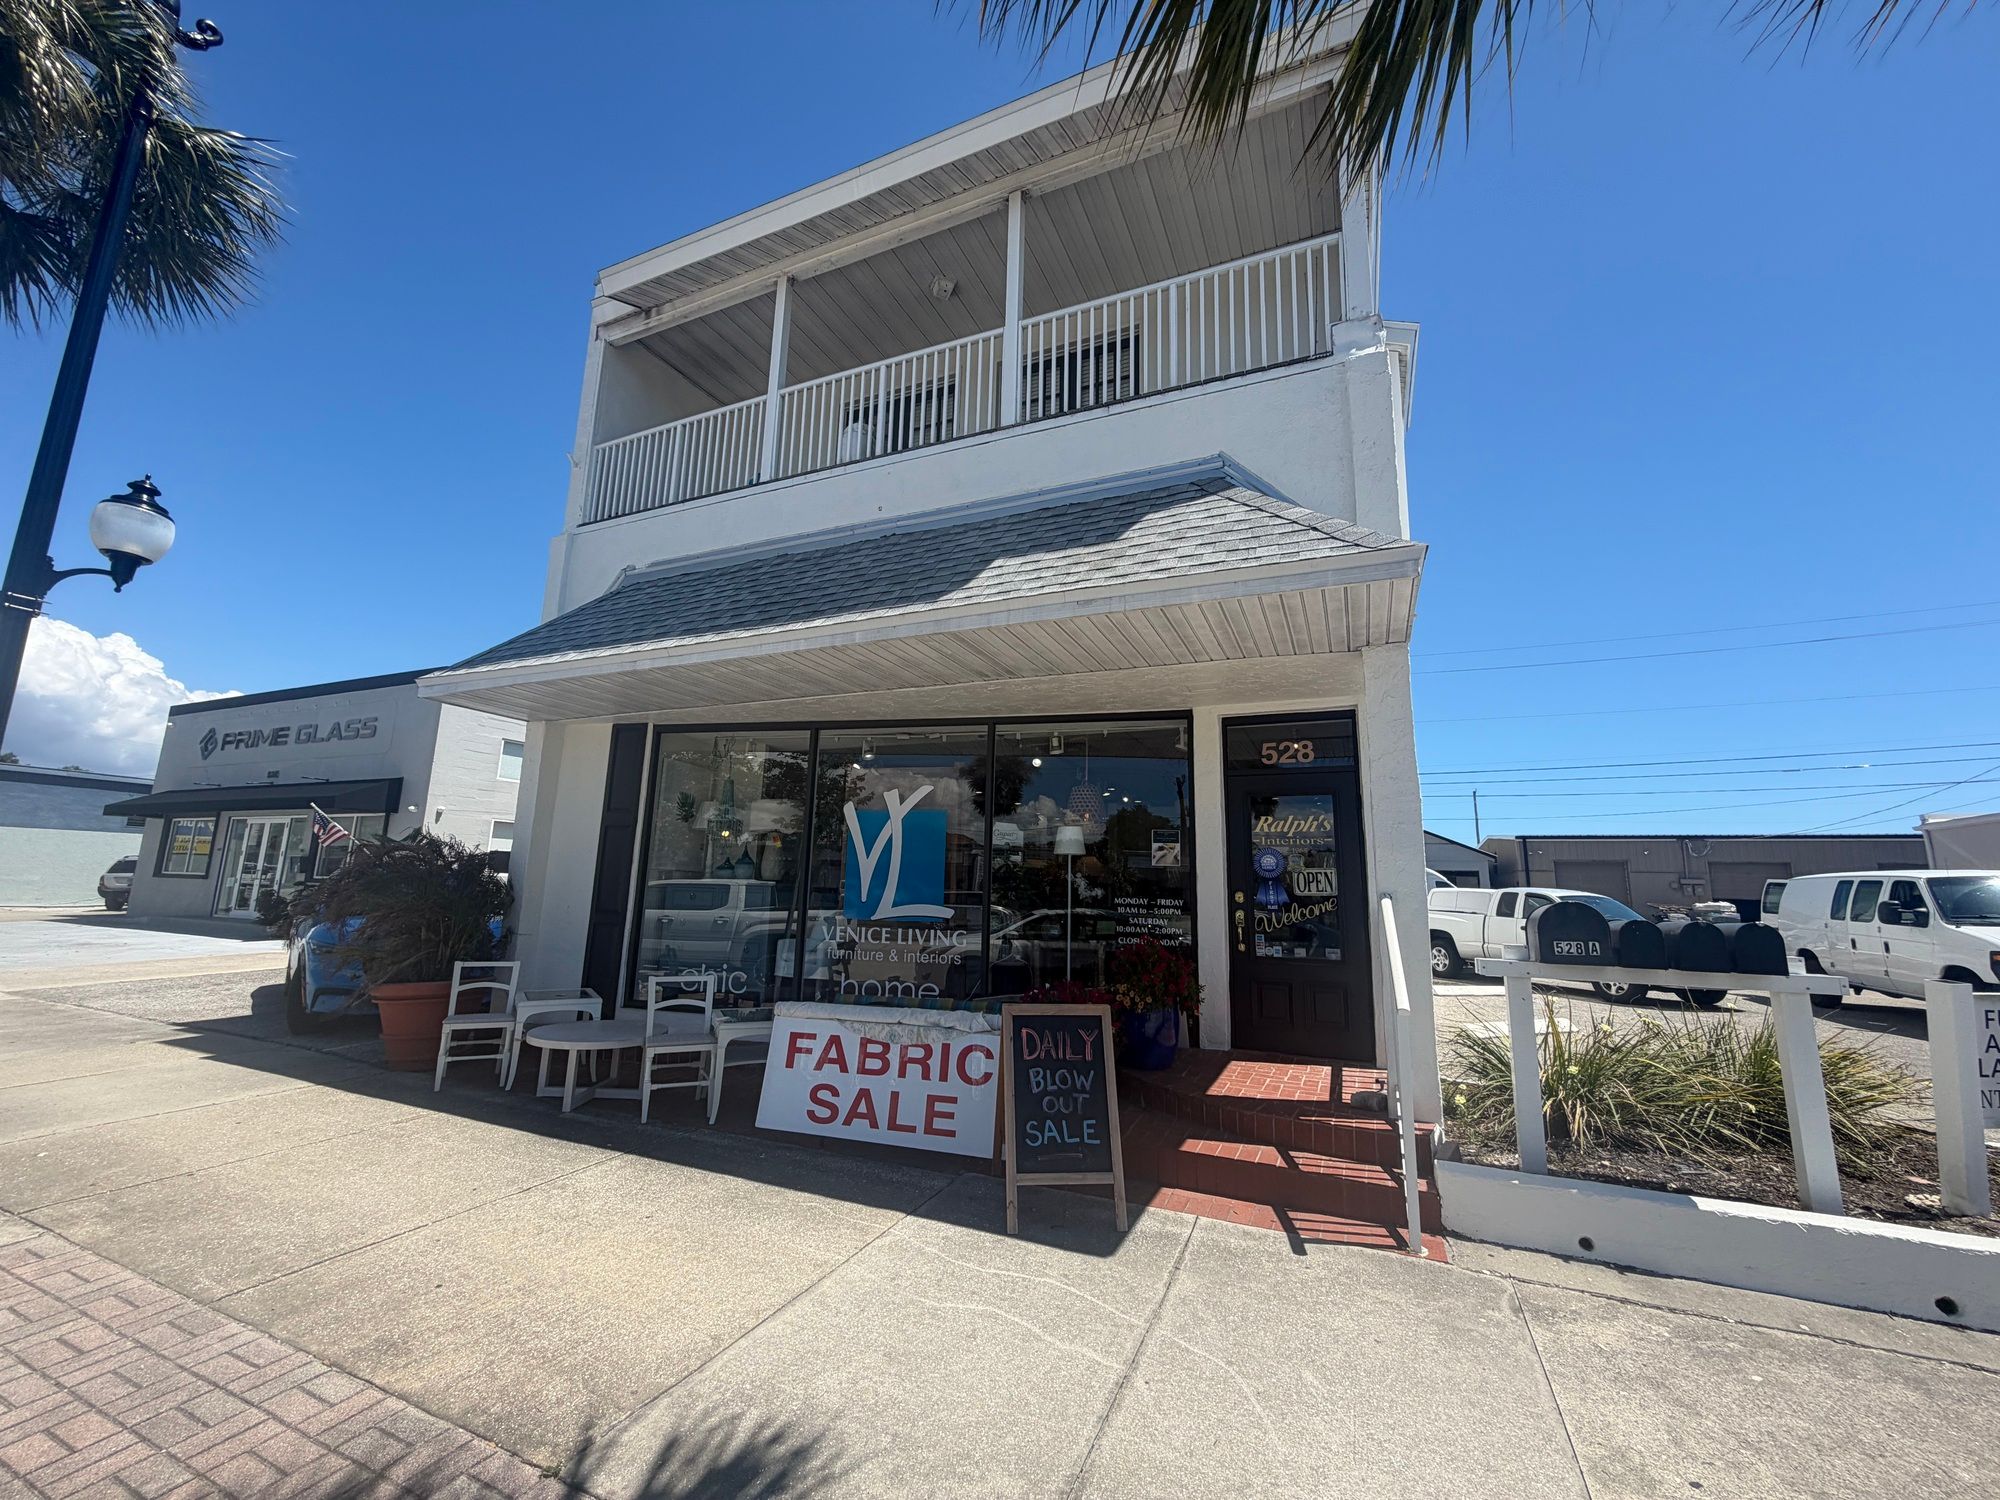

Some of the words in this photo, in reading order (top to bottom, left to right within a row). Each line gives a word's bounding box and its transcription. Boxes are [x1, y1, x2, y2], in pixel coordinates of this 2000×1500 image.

[220, 726, 290, 751] PRIME
[295, 716, 378, 745] GLASS
[1261, 740, 1315, 765] 528
[1253, 815, 1331, 837] Ralph's
[1261, 836, 1325, 846] Interiors
[1296, 871, 1334, 893] OPEN
[1114, 897, 1149, 905] MONDAY
[1157, 899, 1185, 907] FRIDAY
[1255, 897, 1338, 932] Welcome
[1128, 917, 1169, 926] SATURDAY
[822, 925, 890, 944] VENICE
[897, 927, 968, 947] LIVING
[1555, 942, 1584, 955] 528
[1591, 942, 1599, 955] A
[827, 947, 884, 962] furniture
[888, 950, 898, 962] &
[903, 949, 962, 965] interiors
[680, 963, 748, 994] chic
[840, 972, 940, 999] home
[1020, 1027, 1098, 1061] DAILY
[784, 1031, 995, 1087] FABRIC
[1028, 1067, 1095, 1094] BLOW
[806, 1083, 959, 1138] SALE
[1042, 1093, 1090, 1115] OUT
[1026, 1119, 1101, 1147] SALE
